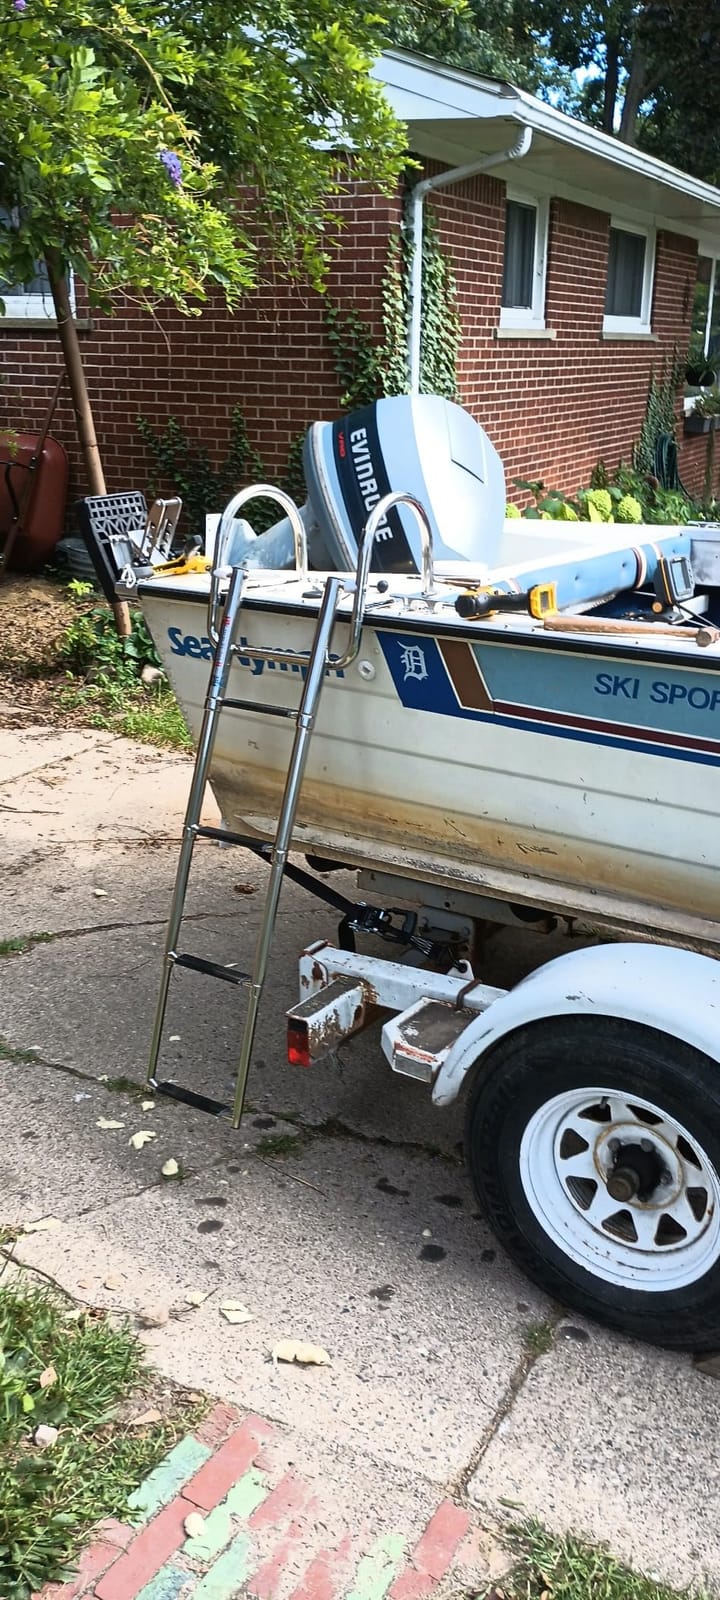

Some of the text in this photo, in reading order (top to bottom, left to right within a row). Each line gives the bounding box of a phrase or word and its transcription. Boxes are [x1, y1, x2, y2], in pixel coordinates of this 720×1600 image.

[350, 427, 393, 543] EVINRUE
[167, 627, 217, 661] Sea
[594, 673, 640, 699] SKI
